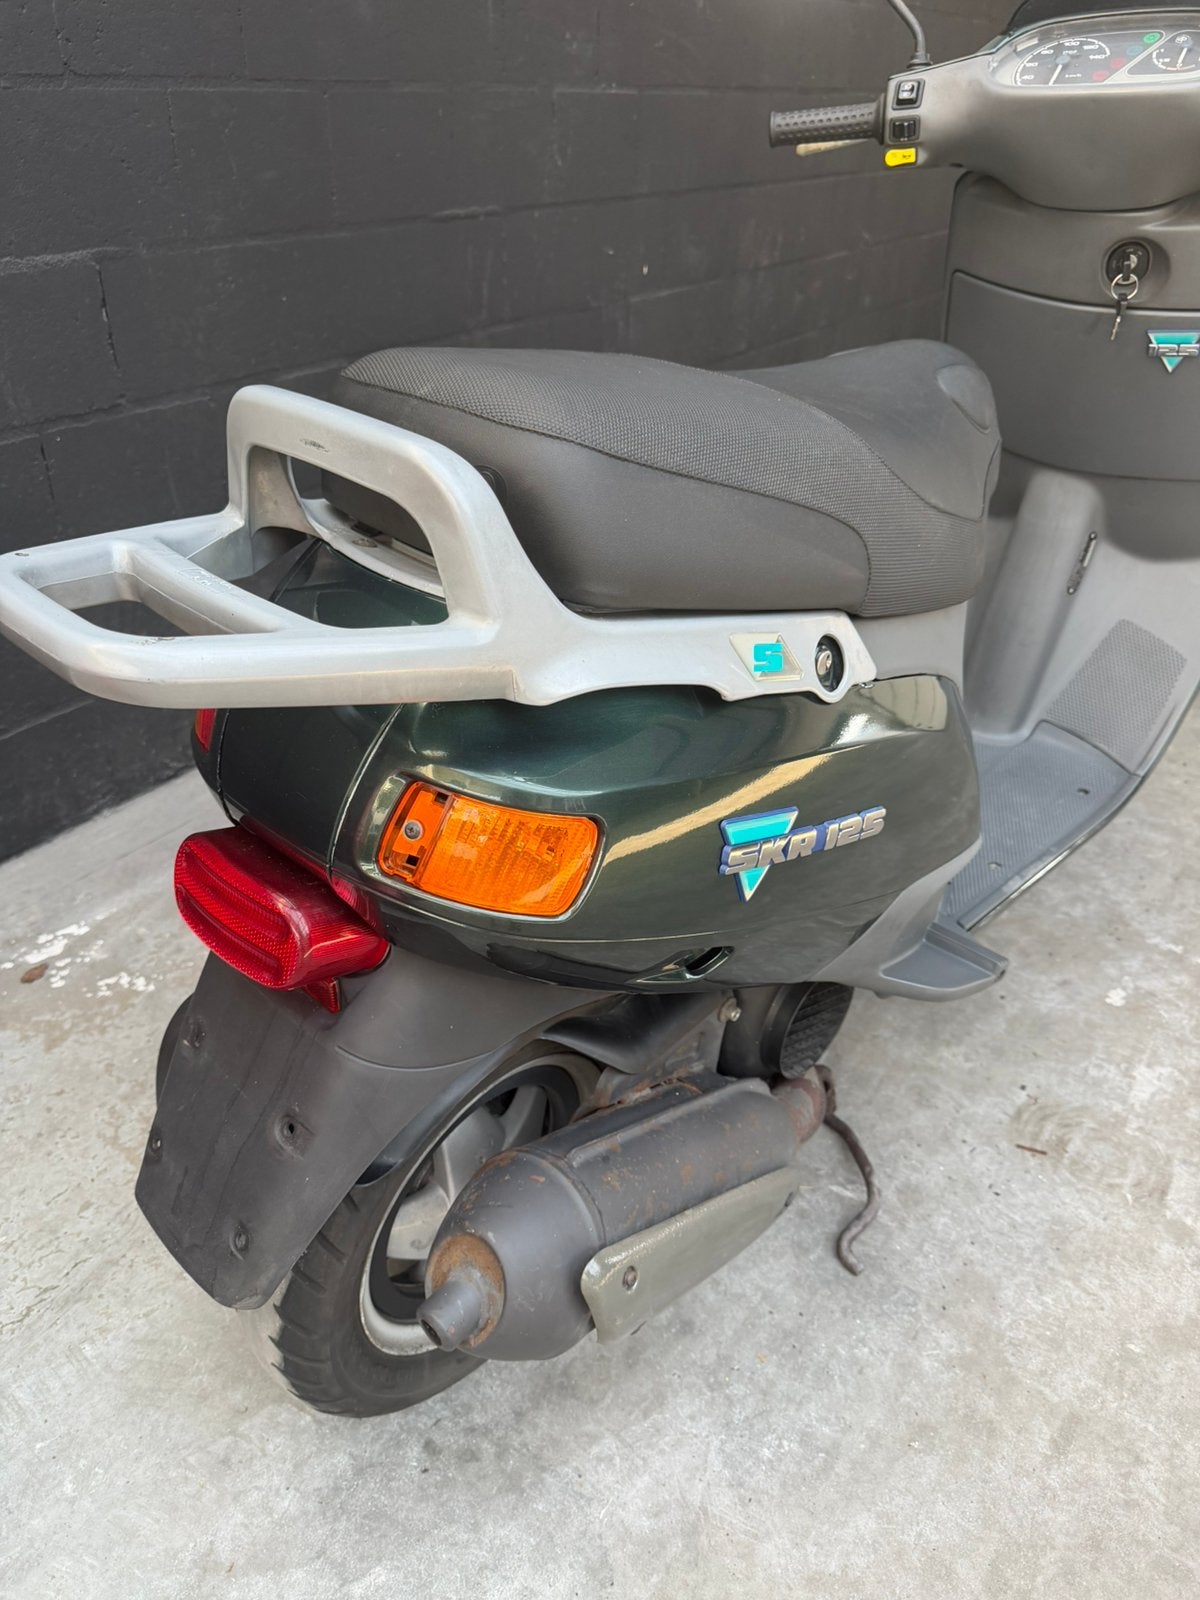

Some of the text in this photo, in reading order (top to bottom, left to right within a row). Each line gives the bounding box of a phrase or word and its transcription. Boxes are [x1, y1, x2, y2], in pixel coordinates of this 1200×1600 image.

[1148, 343, 1200, 357] 125
[753, 642, 783, 673] S
[720, 806, 887, 876] SKR 125
